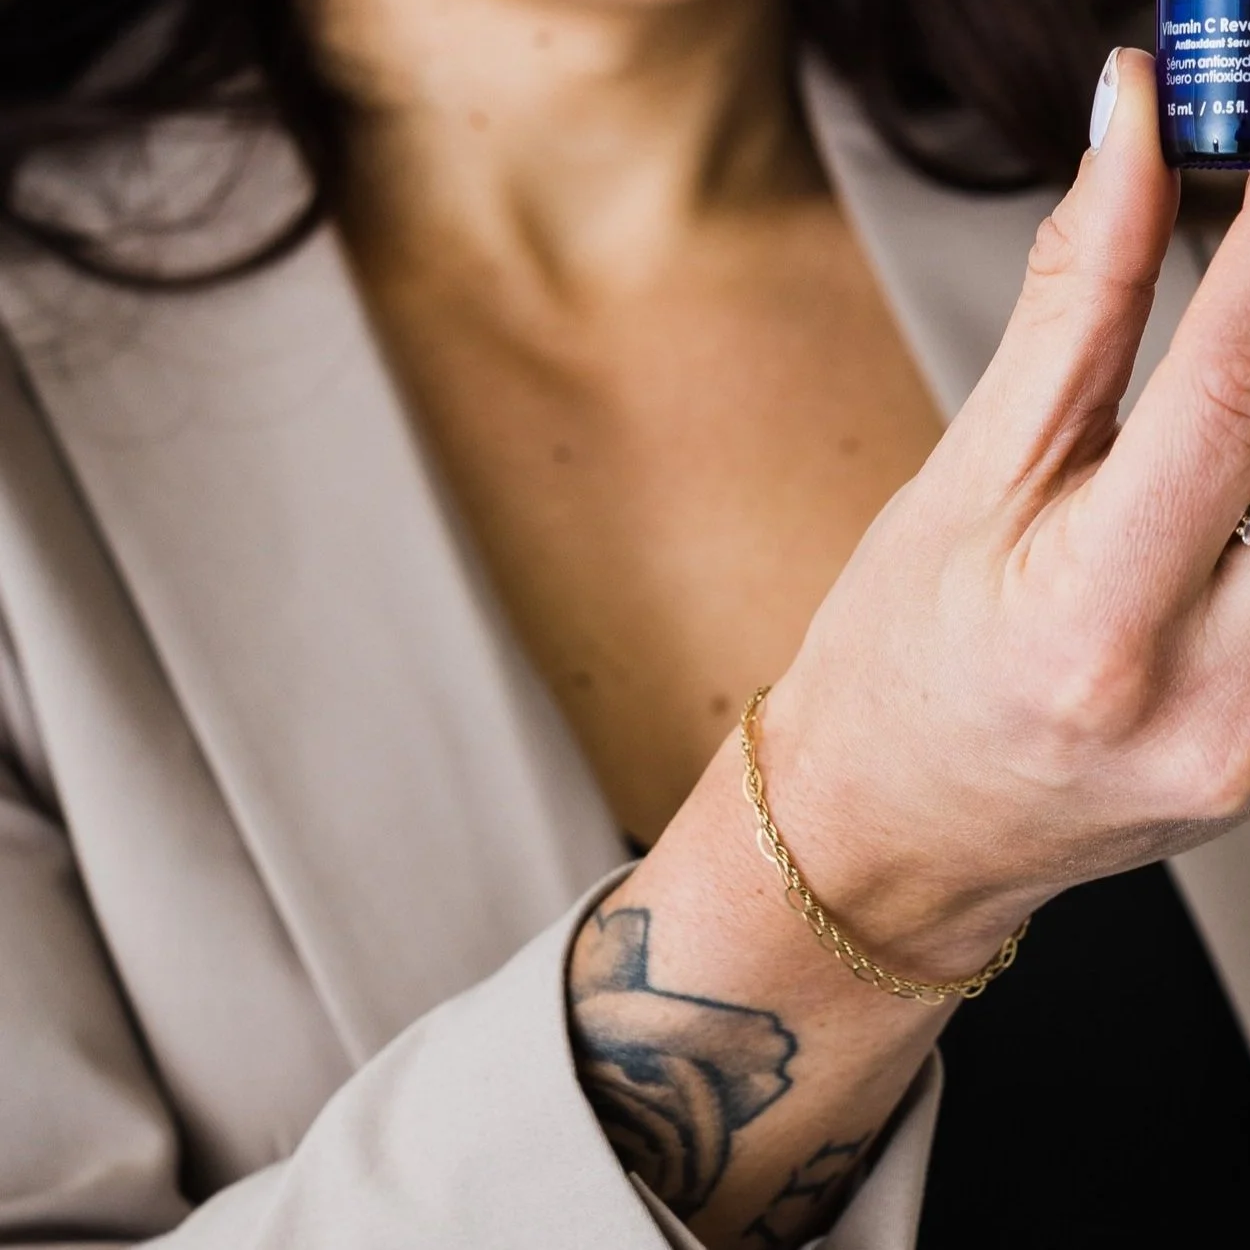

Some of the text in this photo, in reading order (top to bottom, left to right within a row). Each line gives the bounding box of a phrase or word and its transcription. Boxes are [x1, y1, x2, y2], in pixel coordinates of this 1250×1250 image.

[1162, 18, 1201, 36] Vitamin
[1204, 17, 1216, 34] C
[1174, 38, 1226, 51] Antioxidant
[1166, 56, 1196, 71] Sérum
[1166, 72, 1192, 86] Suero
[1200, 101, 1207, 117] /
[1212, 100, 1235, 115] 0.5
